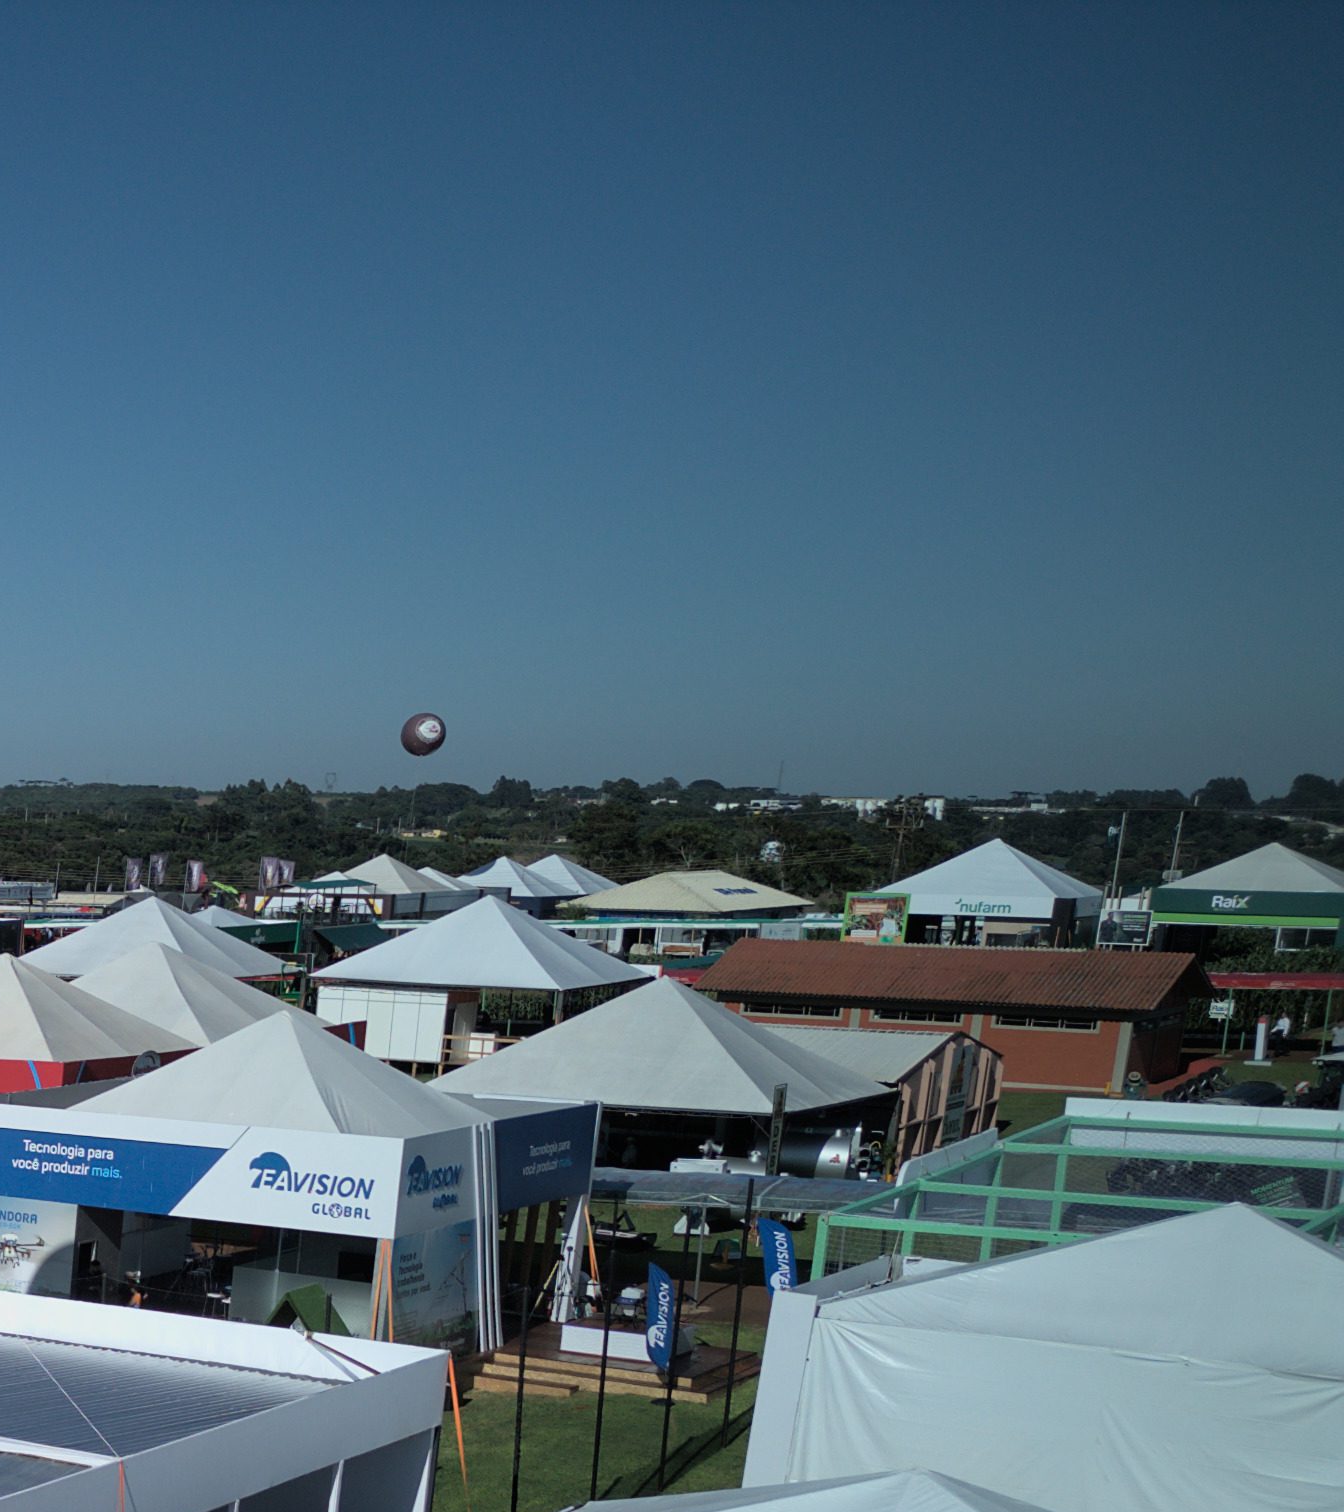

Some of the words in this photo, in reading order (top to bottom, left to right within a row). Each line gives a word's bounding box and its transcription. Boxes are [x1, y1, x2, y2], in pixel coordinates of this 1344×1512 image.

[960, 900, 1012, 914] nufarm
[23, 1139, 85, 1159] Tecnologia
[87, 1149, 115, 1162] para
[12, 1157, 39, 1171] você
[41, 1161, 90, 1176] produzir
[91, 1166, 123, 1179] mais.
[312, 1203, 372, 1221] GLOBAL
